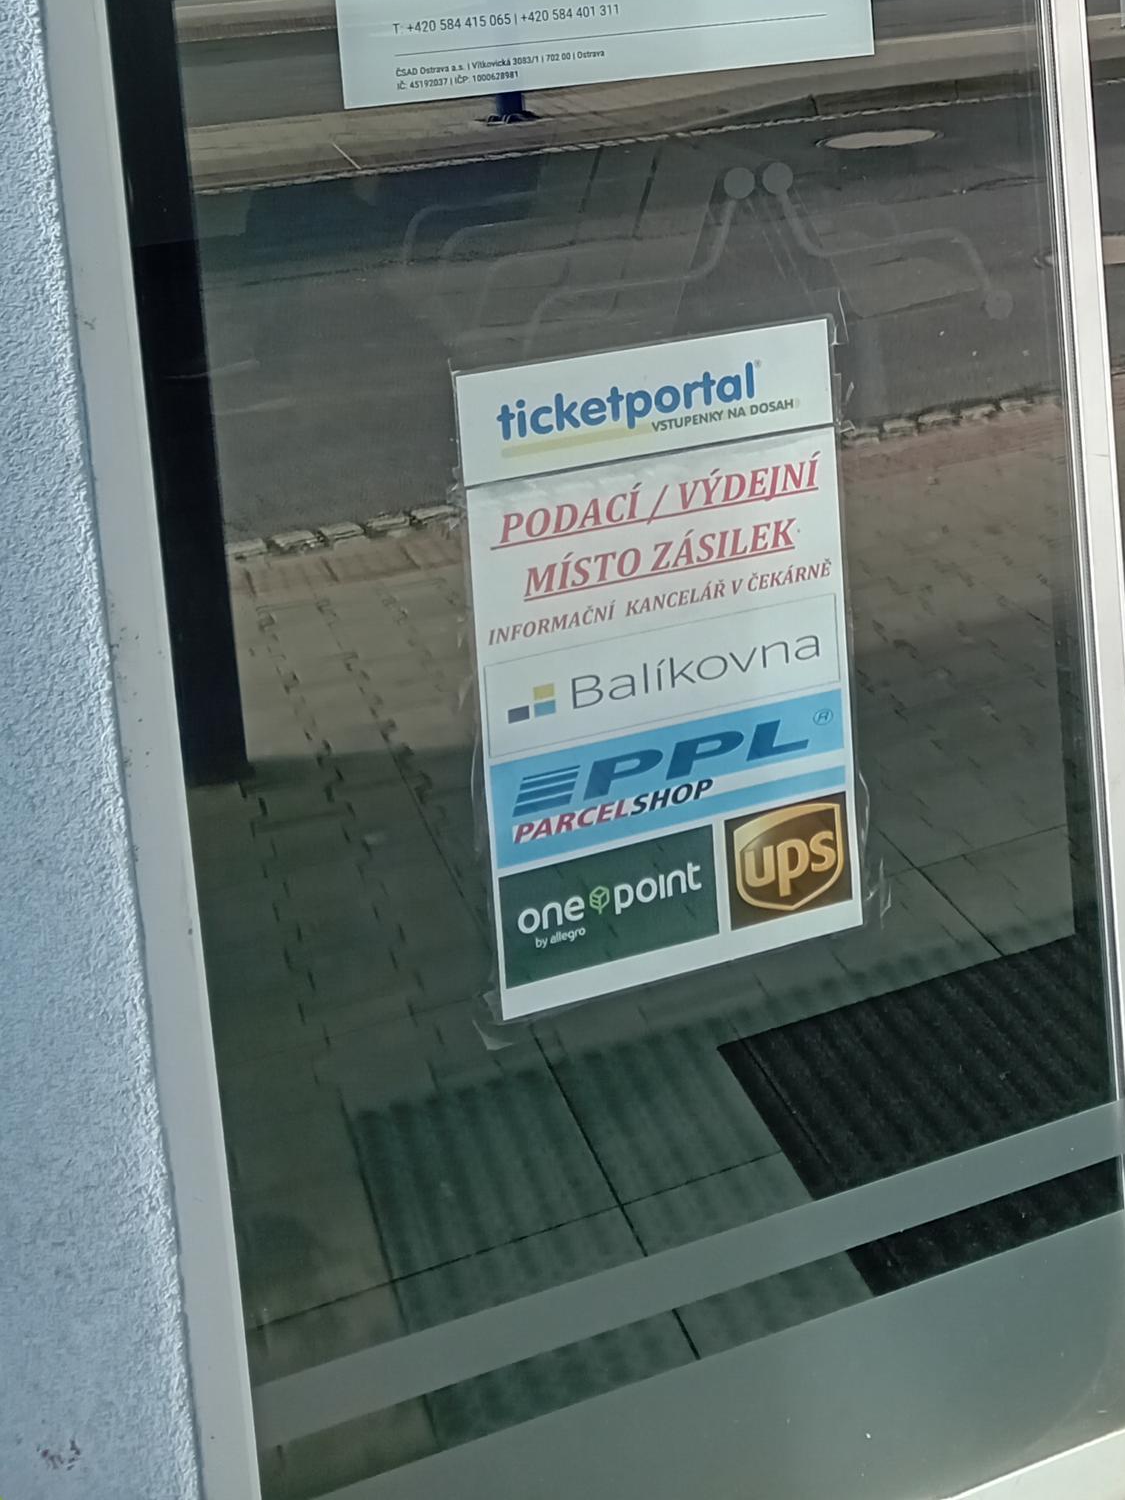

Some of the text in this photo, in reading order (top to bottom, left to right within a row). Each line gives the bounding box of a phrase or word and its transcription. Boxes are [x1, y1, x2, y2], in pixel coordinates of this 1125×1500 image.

[407, 20, 436, 33] +420
[440, 18, 461, 31] 584
[464, 15, 487, 28] 415
[489, 13, 512, 27] 065
[520, 9, 549, 23] +420
[552, 6, 573, 20] 584
[576, 5, 597, 18] 401
[599, 3, 620, 17] 311
[396, 66, 418, 78] ČSAD
[419, 65, 450, 76] Ostrava
[546, 52, 560, 63] 702
[561, 52, 572, 62] 00
[577, 50, 605, 60] Ostrava
[497, 361, 756, 441] ticketportal
[652, 399, 794, 432] VSTUPENKY NA DOSAH
[498, 451, 821, 544] PODACÍ / VÝDEJNÍ
[523, 517, 797, 598] MÍSTO ZÁSILEK
[488, 558, 832, 646] INFORMAČNÍ KANCELÁŘ V ČEKÁRNĚ
[570, 633, 821, 710] Balíkovna
[583, 719, 810, 801] PPL
[513, 777, 714, 844] PARCELSHOP
[517, 862, 702, 935] one point
[743, 830, 837, 897] ups
[535, 926, 586, 949] by allegro
